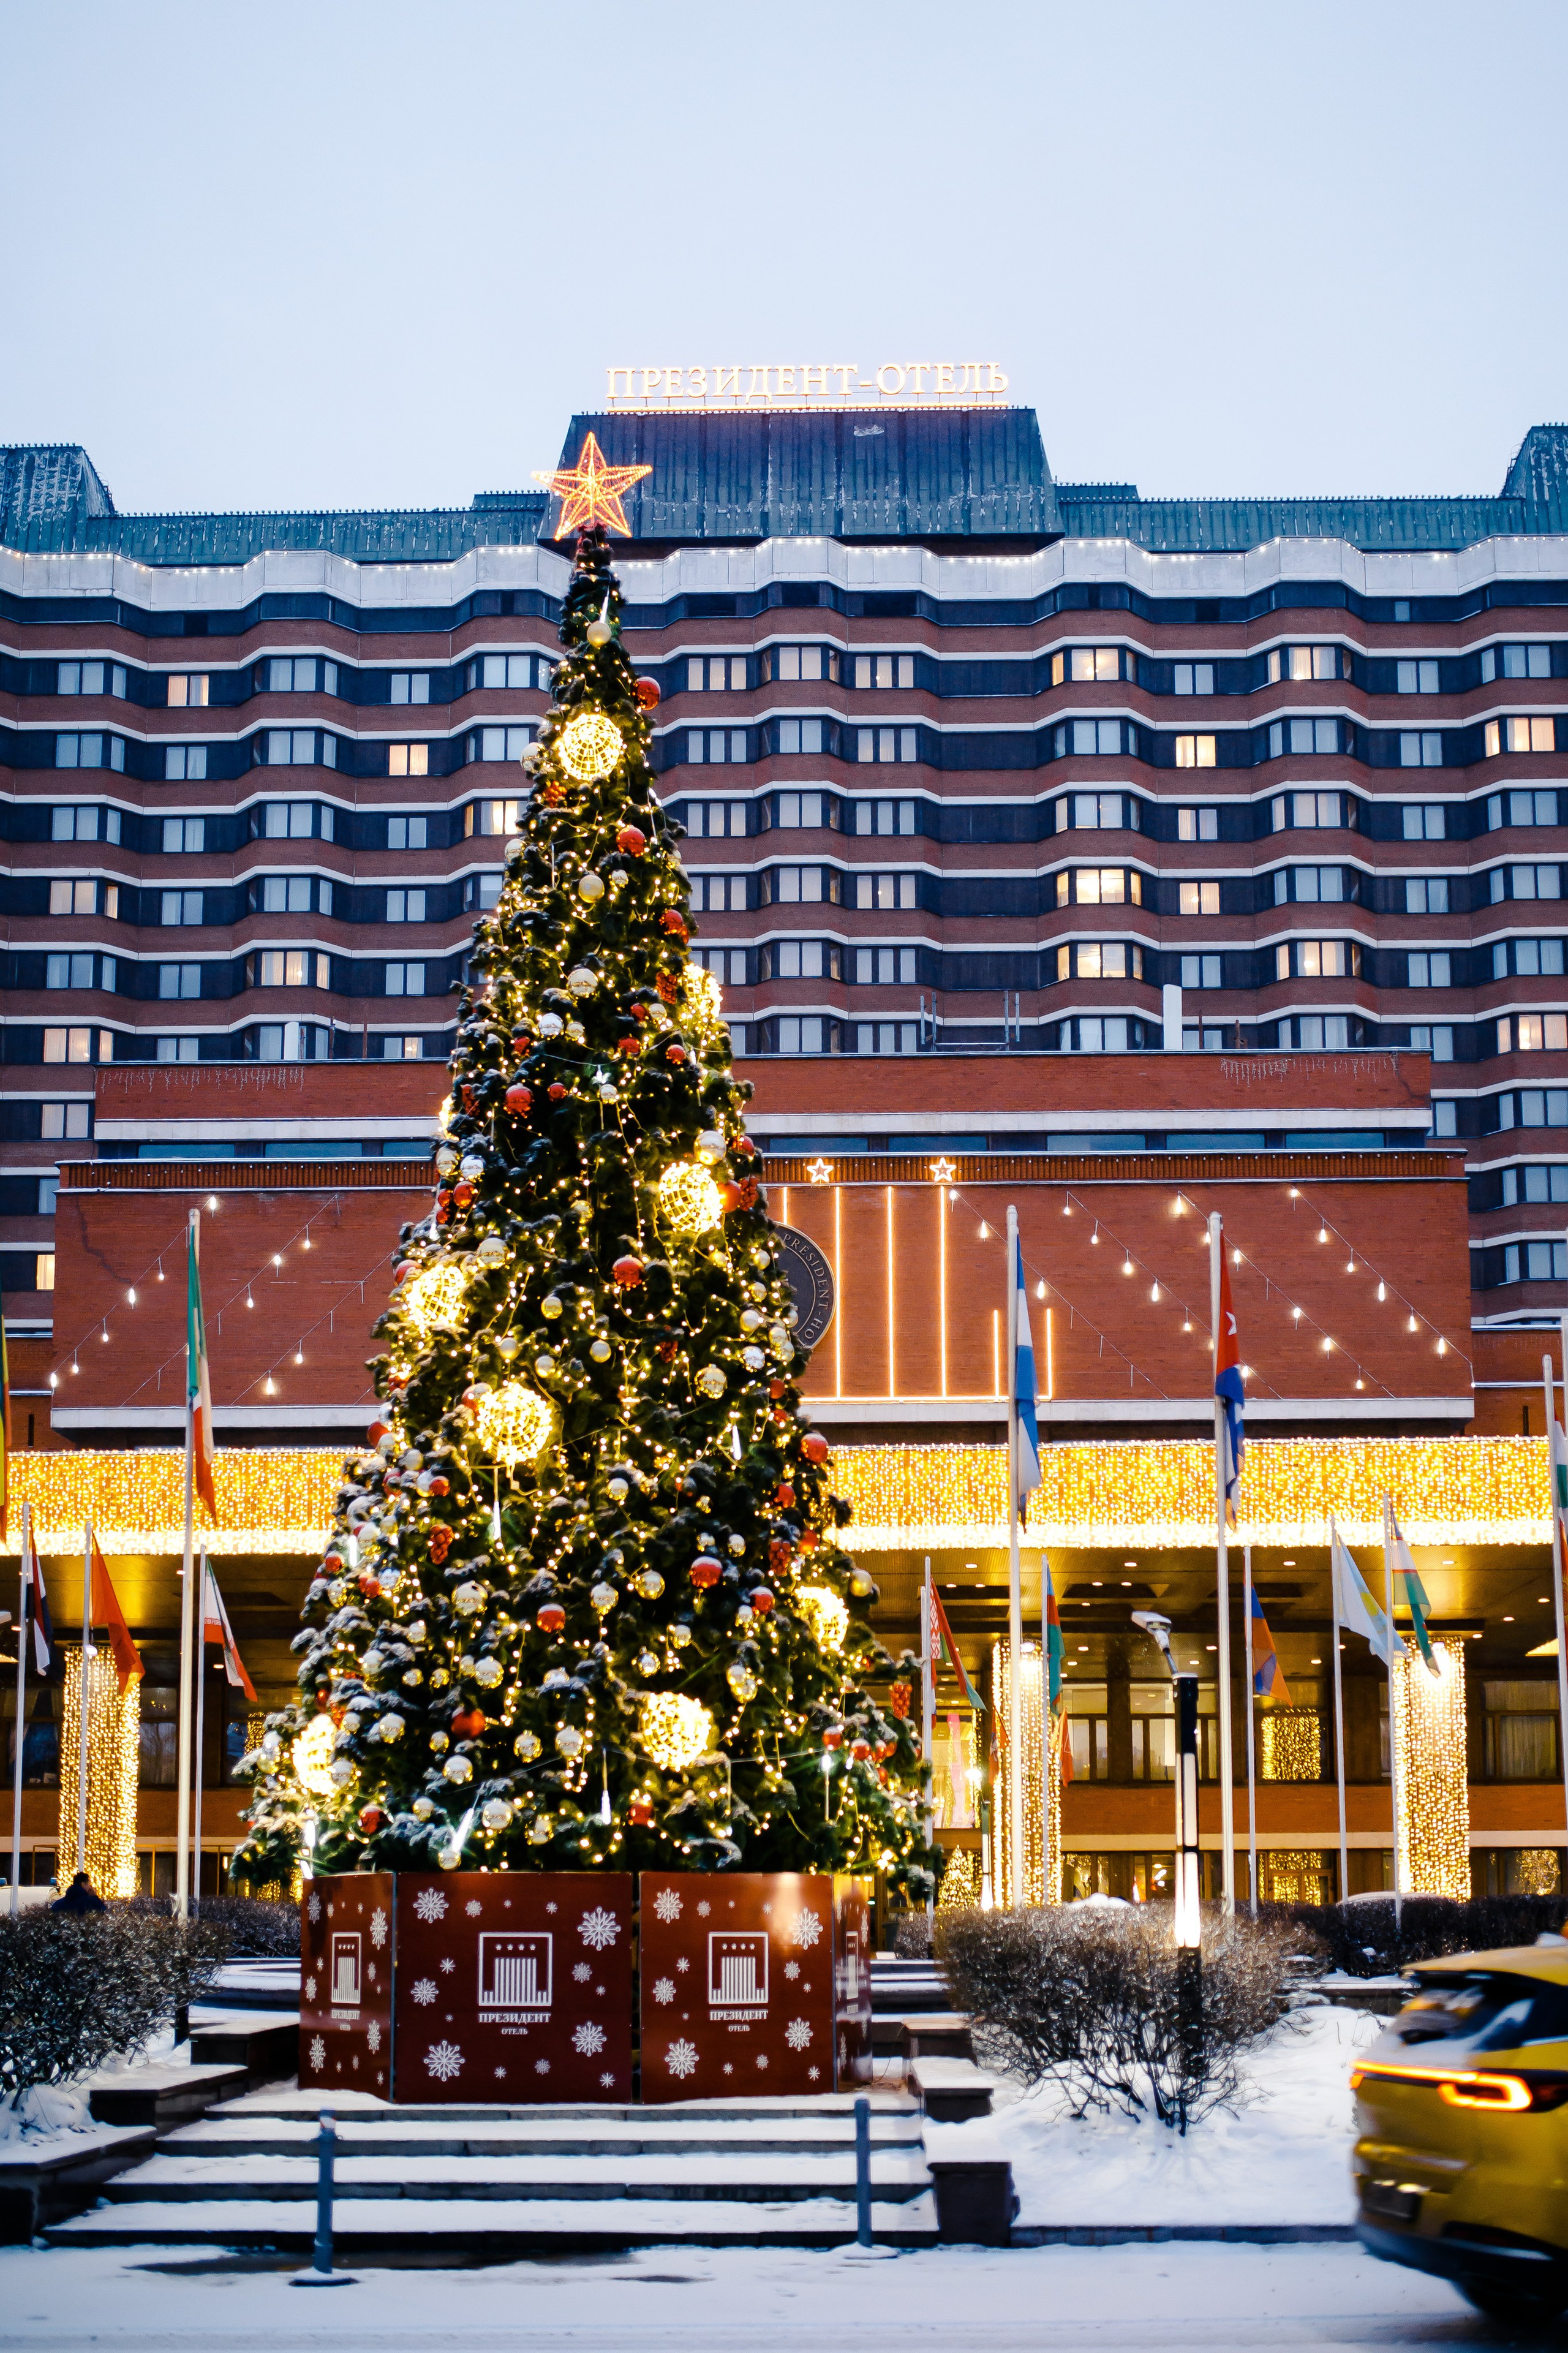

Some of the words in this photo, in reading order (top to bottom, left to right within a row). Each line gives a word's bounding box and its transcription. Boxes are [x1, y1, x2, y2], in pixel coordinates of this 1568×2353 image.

[606, 362, 1009, 404] ПРЕЗИДЕНТ-ОТЕЛЬ
[478, 2013, 551, 2025] ПРЕЗИДЕНТ
[709, 2010, 769, 2022] ПРЕЗИДЕНТ
